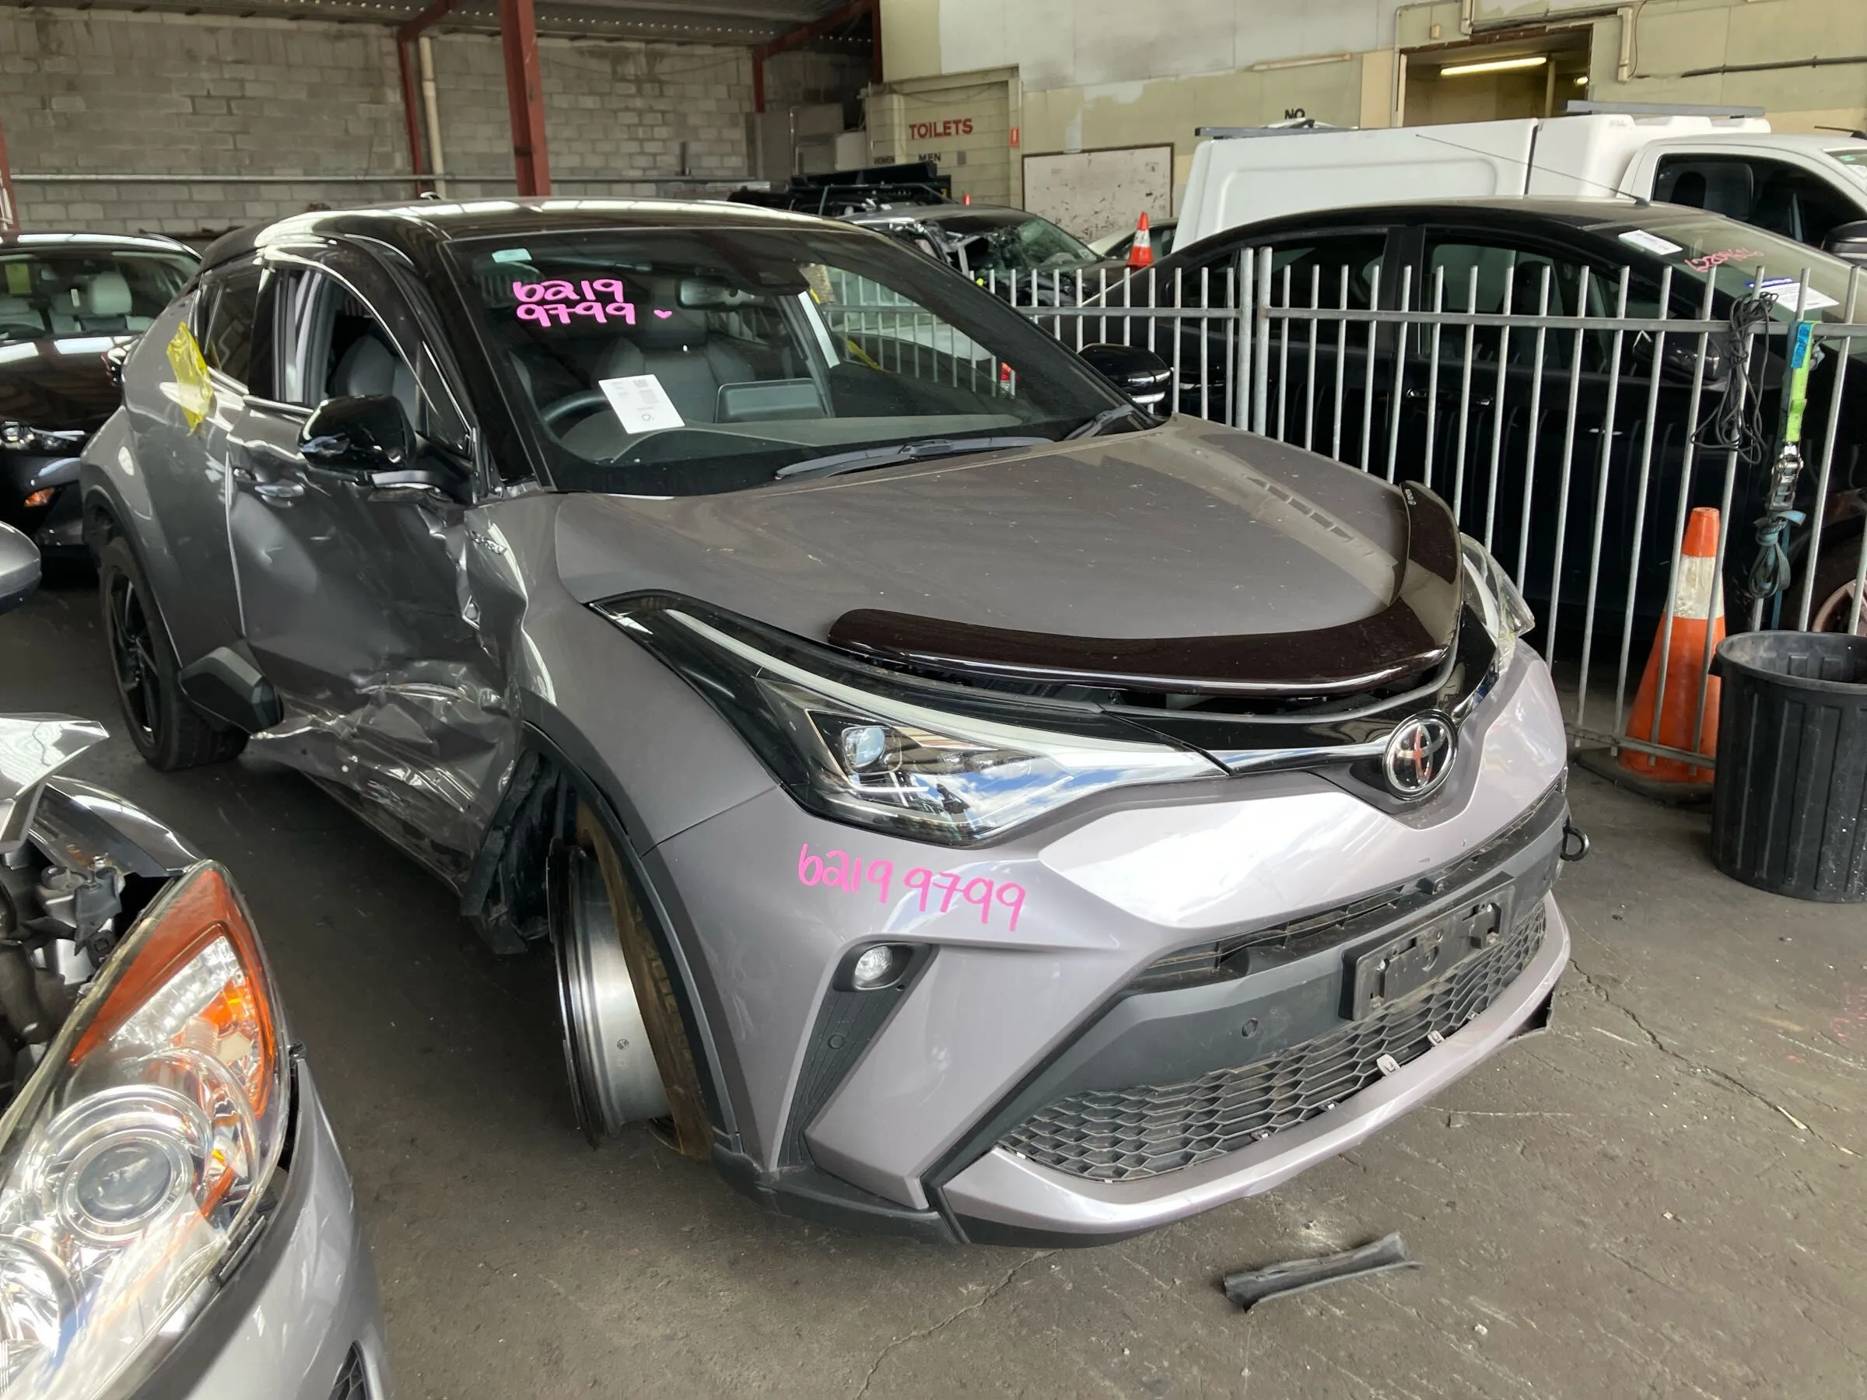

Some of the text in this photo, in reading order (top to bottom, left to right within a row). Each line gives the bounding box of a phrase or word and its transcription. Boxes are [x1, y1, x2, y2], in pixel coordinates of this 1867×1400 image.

[1284, 108, 1305, 120] NO
[909, 118, 973, 140] TOILETS
[918, 152, 941, 162] MEN
[516, 302, 636, 326] 9799
[903, 867, 1026, 932] 9799
